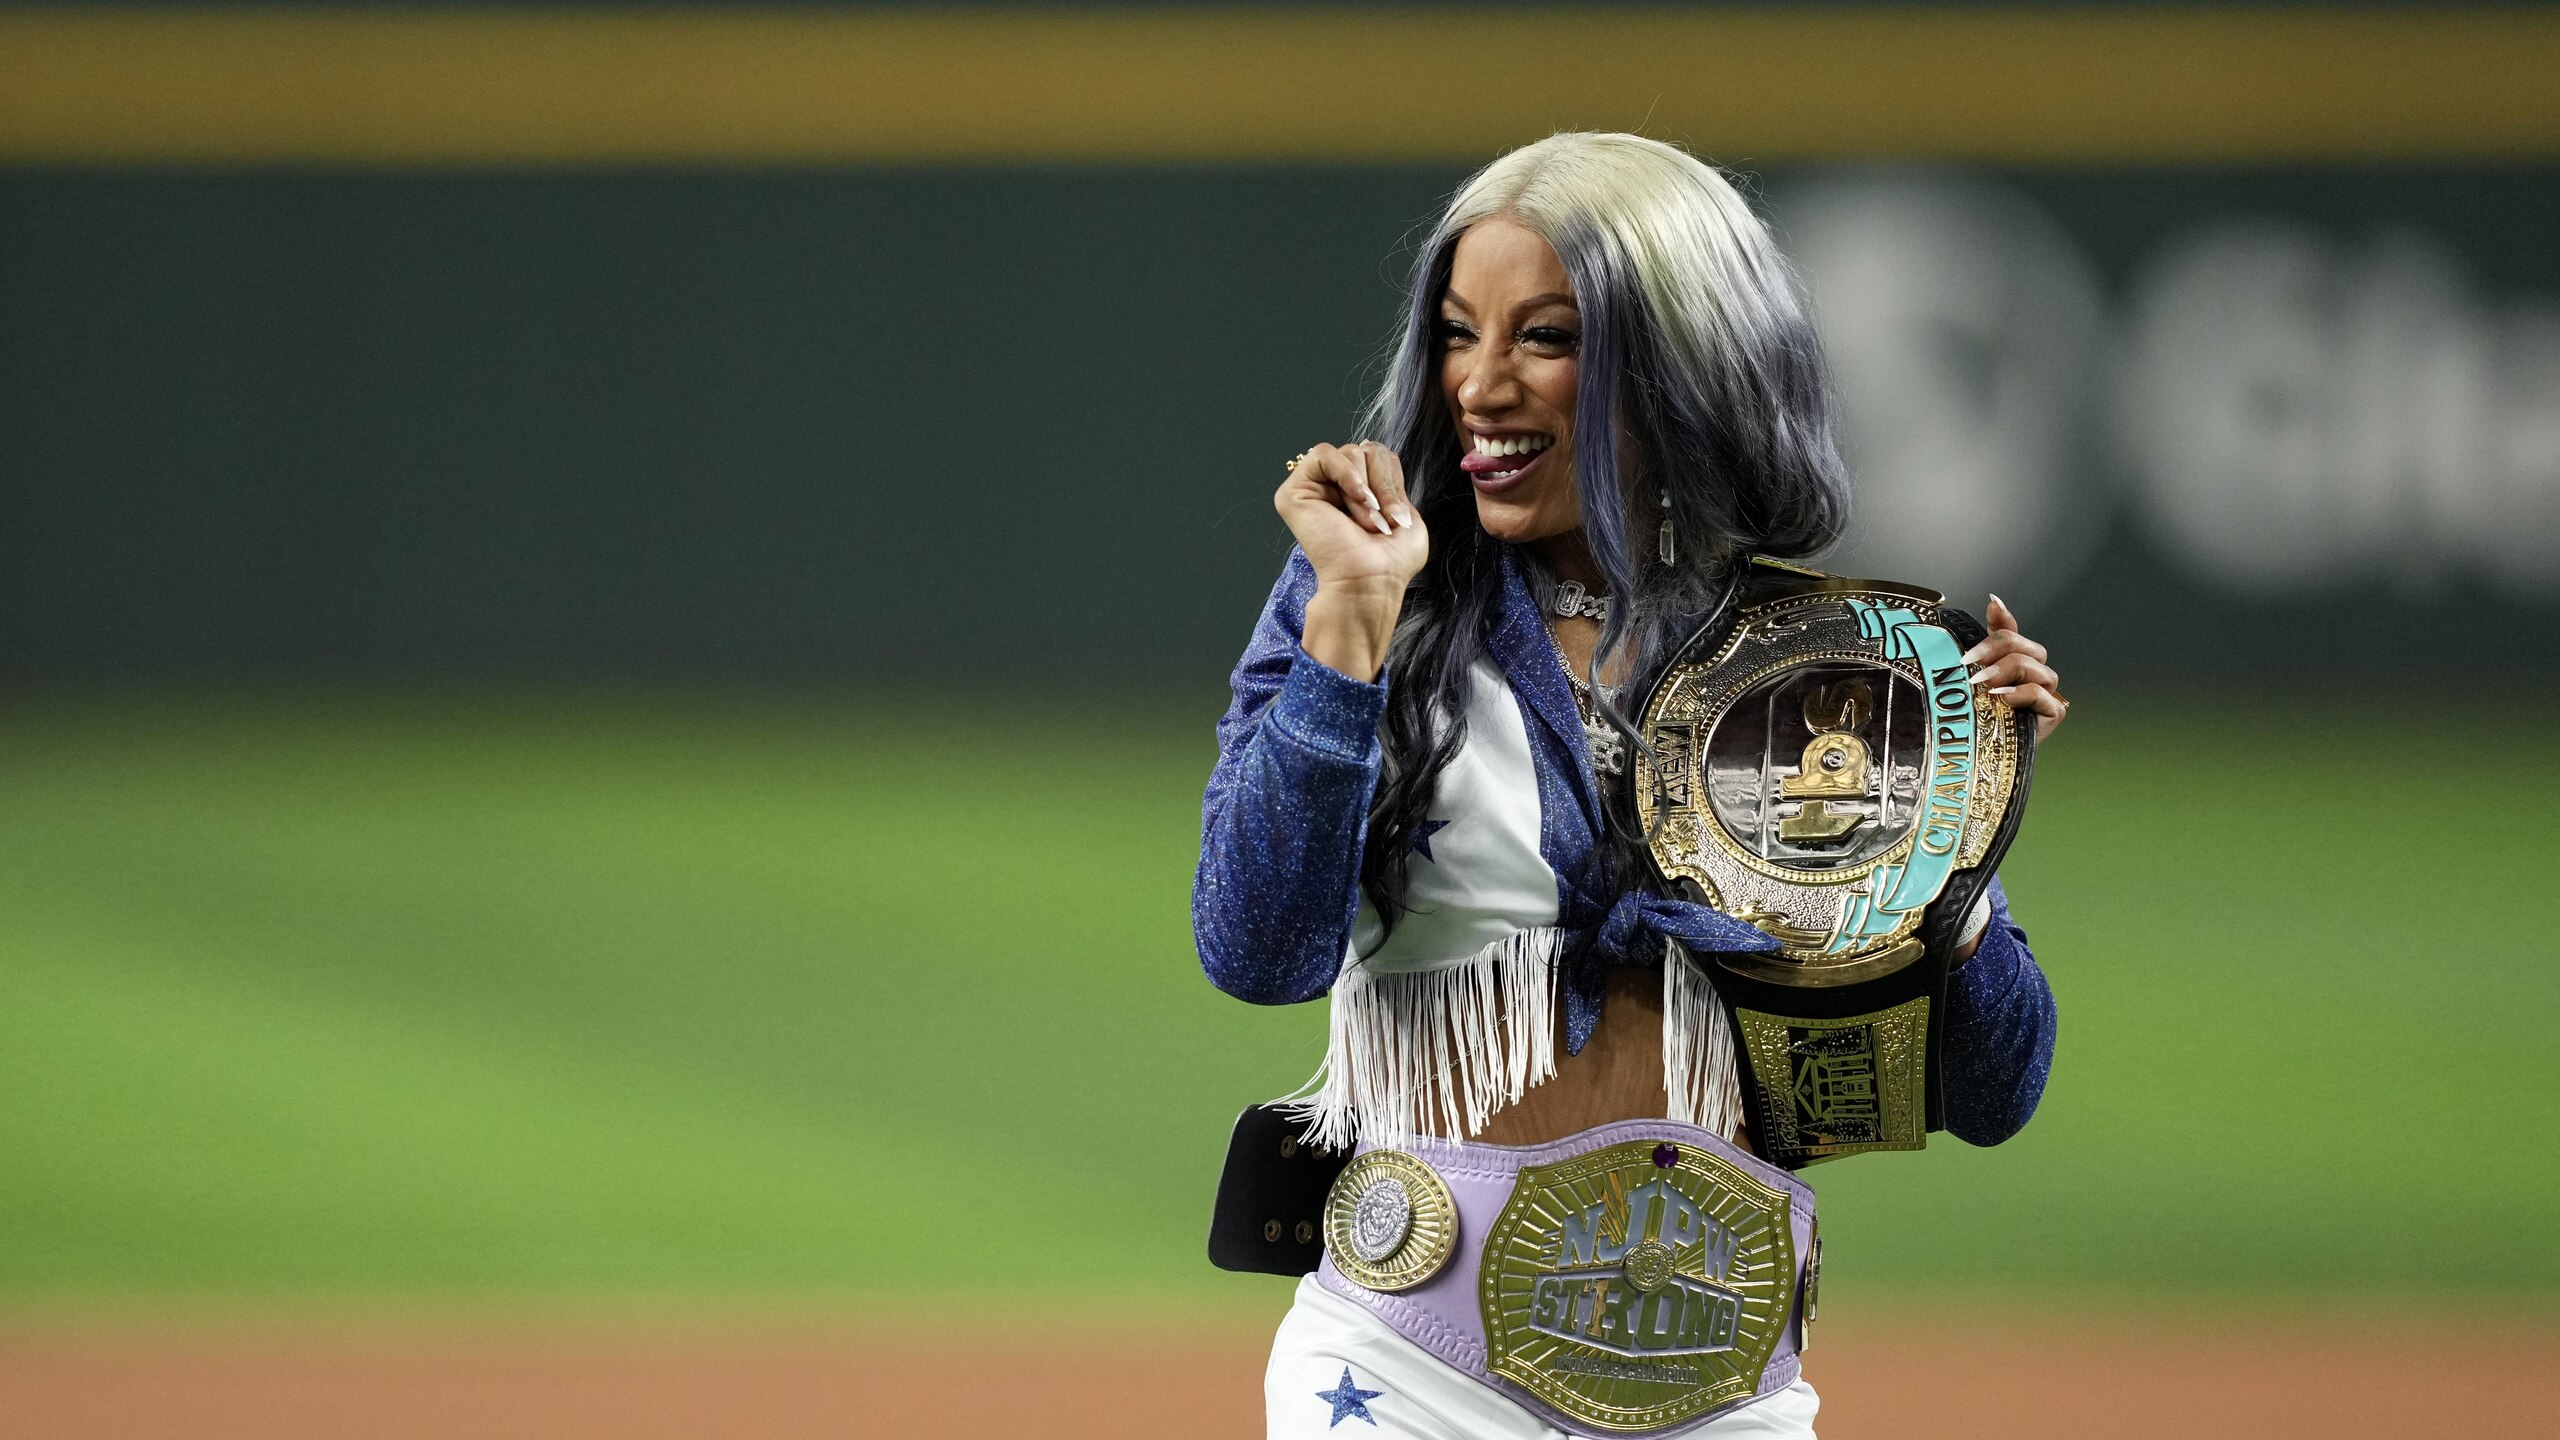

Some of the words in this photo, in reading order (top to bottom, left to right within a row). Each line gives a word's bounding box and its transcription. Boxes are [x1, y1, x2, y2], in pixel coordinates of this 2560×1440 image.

[1653, 728, 1688, 803] AEW
[1918, 664, 1971, 856] CHAMPION
[1552, 1164, 1586, 1182] NEW
[1592, 1148, 1645, 1168] JAPAN
[1684, 1152, 1774, 1207] PRO-WRESTLING
[1557, 1180, 1741, 1281] NJPW
[1535, 1276, 1736, 1349] STRONG
